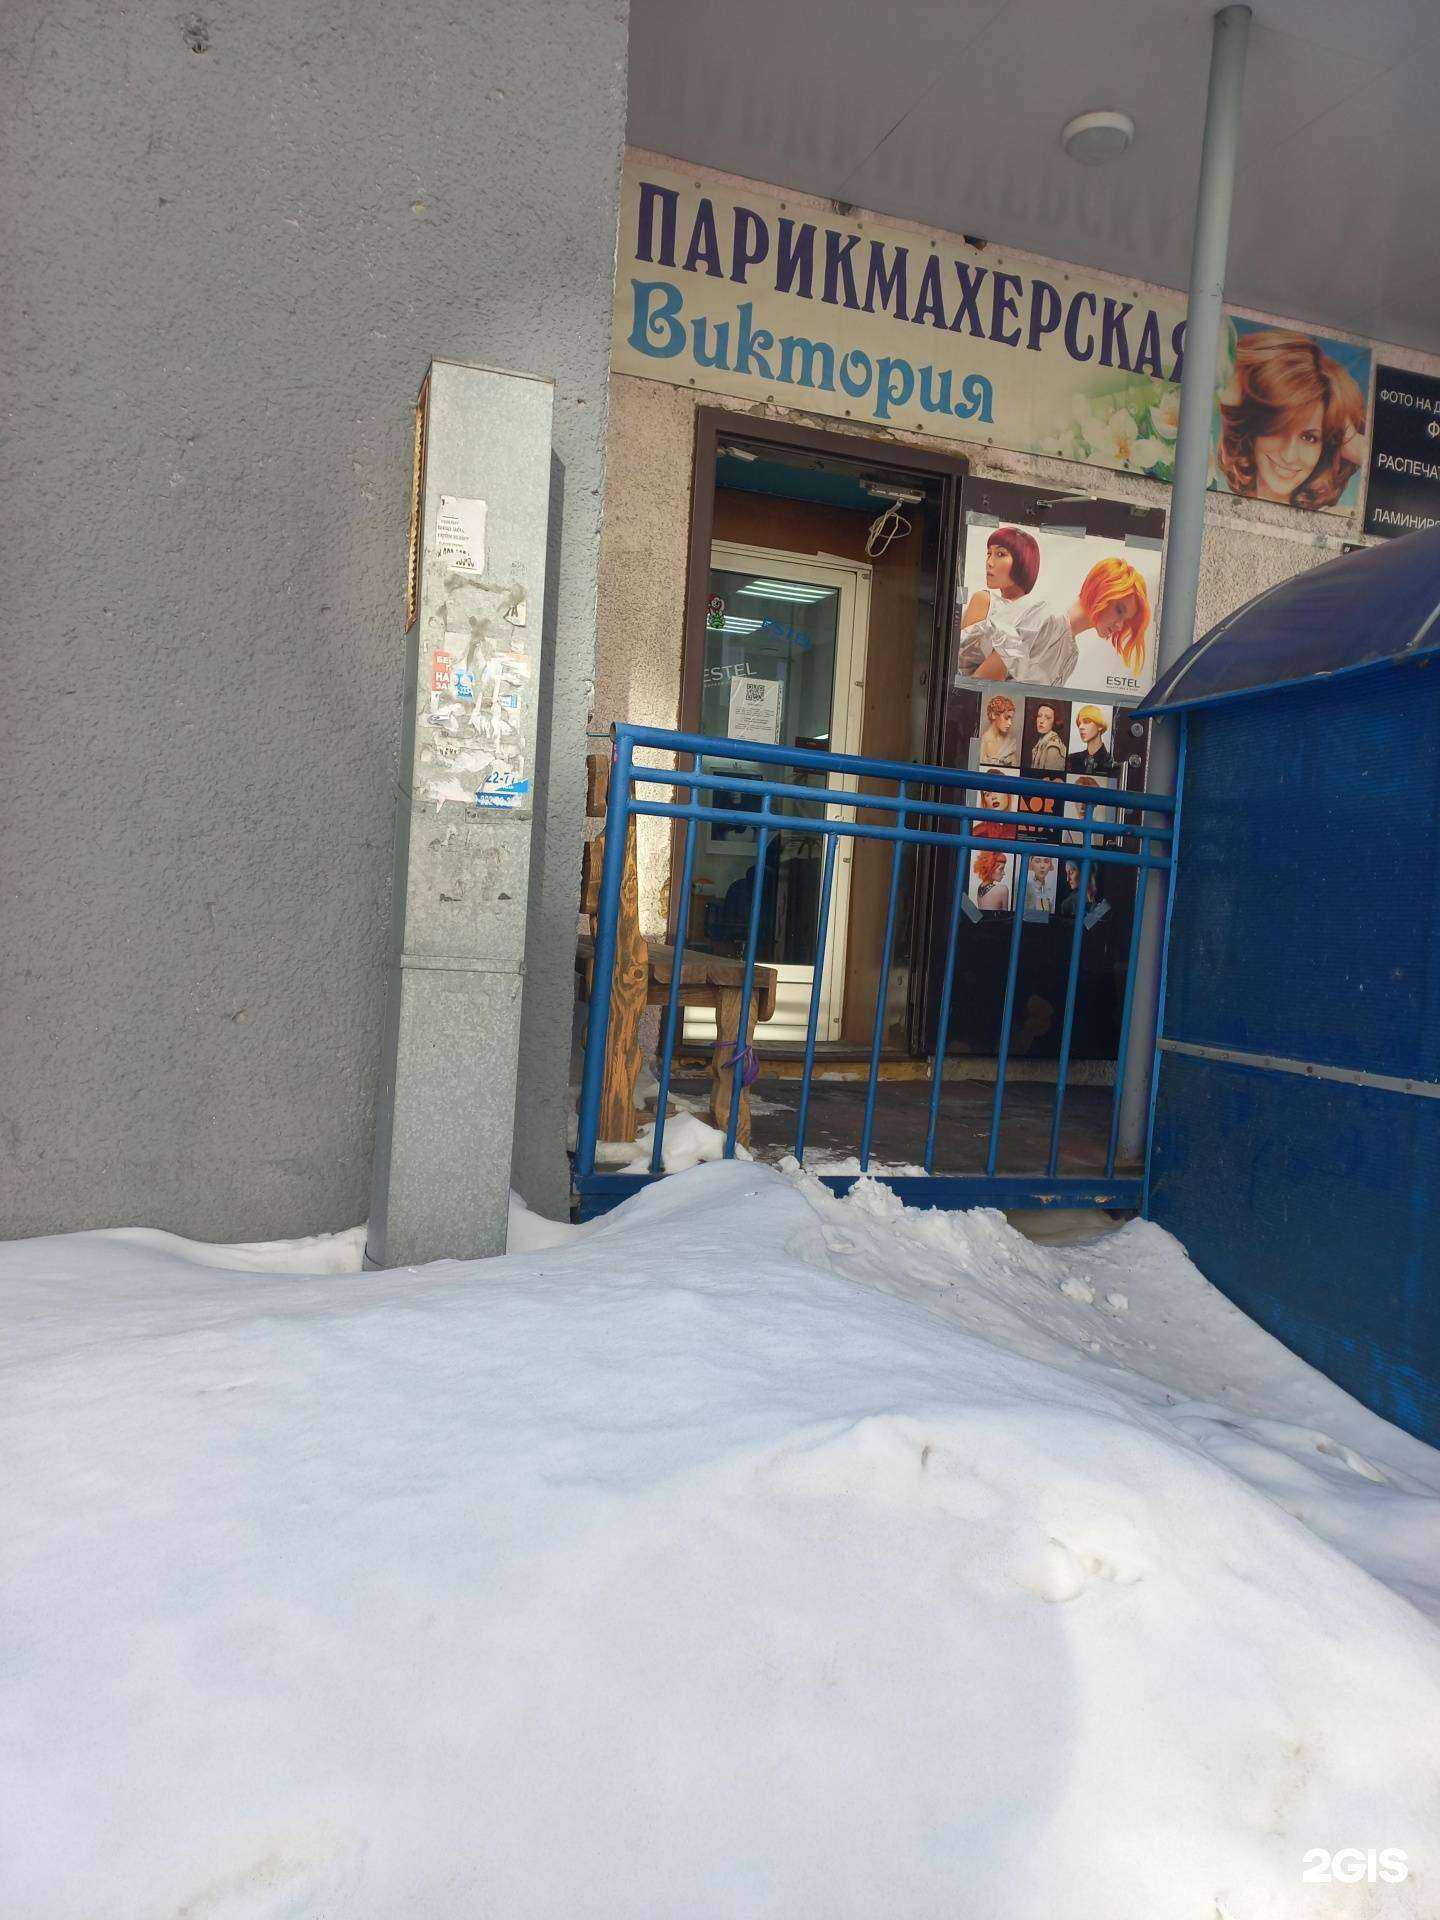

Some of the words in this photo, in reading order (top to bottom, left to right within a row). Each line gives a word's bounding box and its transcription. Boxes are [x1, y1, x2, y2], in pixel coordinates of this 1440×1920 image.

[627, 278, 994, 424] Виктория
[1380, 389, 1413, 407] ФОТО
[1416, 396, 1431, 411] НА
[1106, 675, 1141, 688] ESTEL
